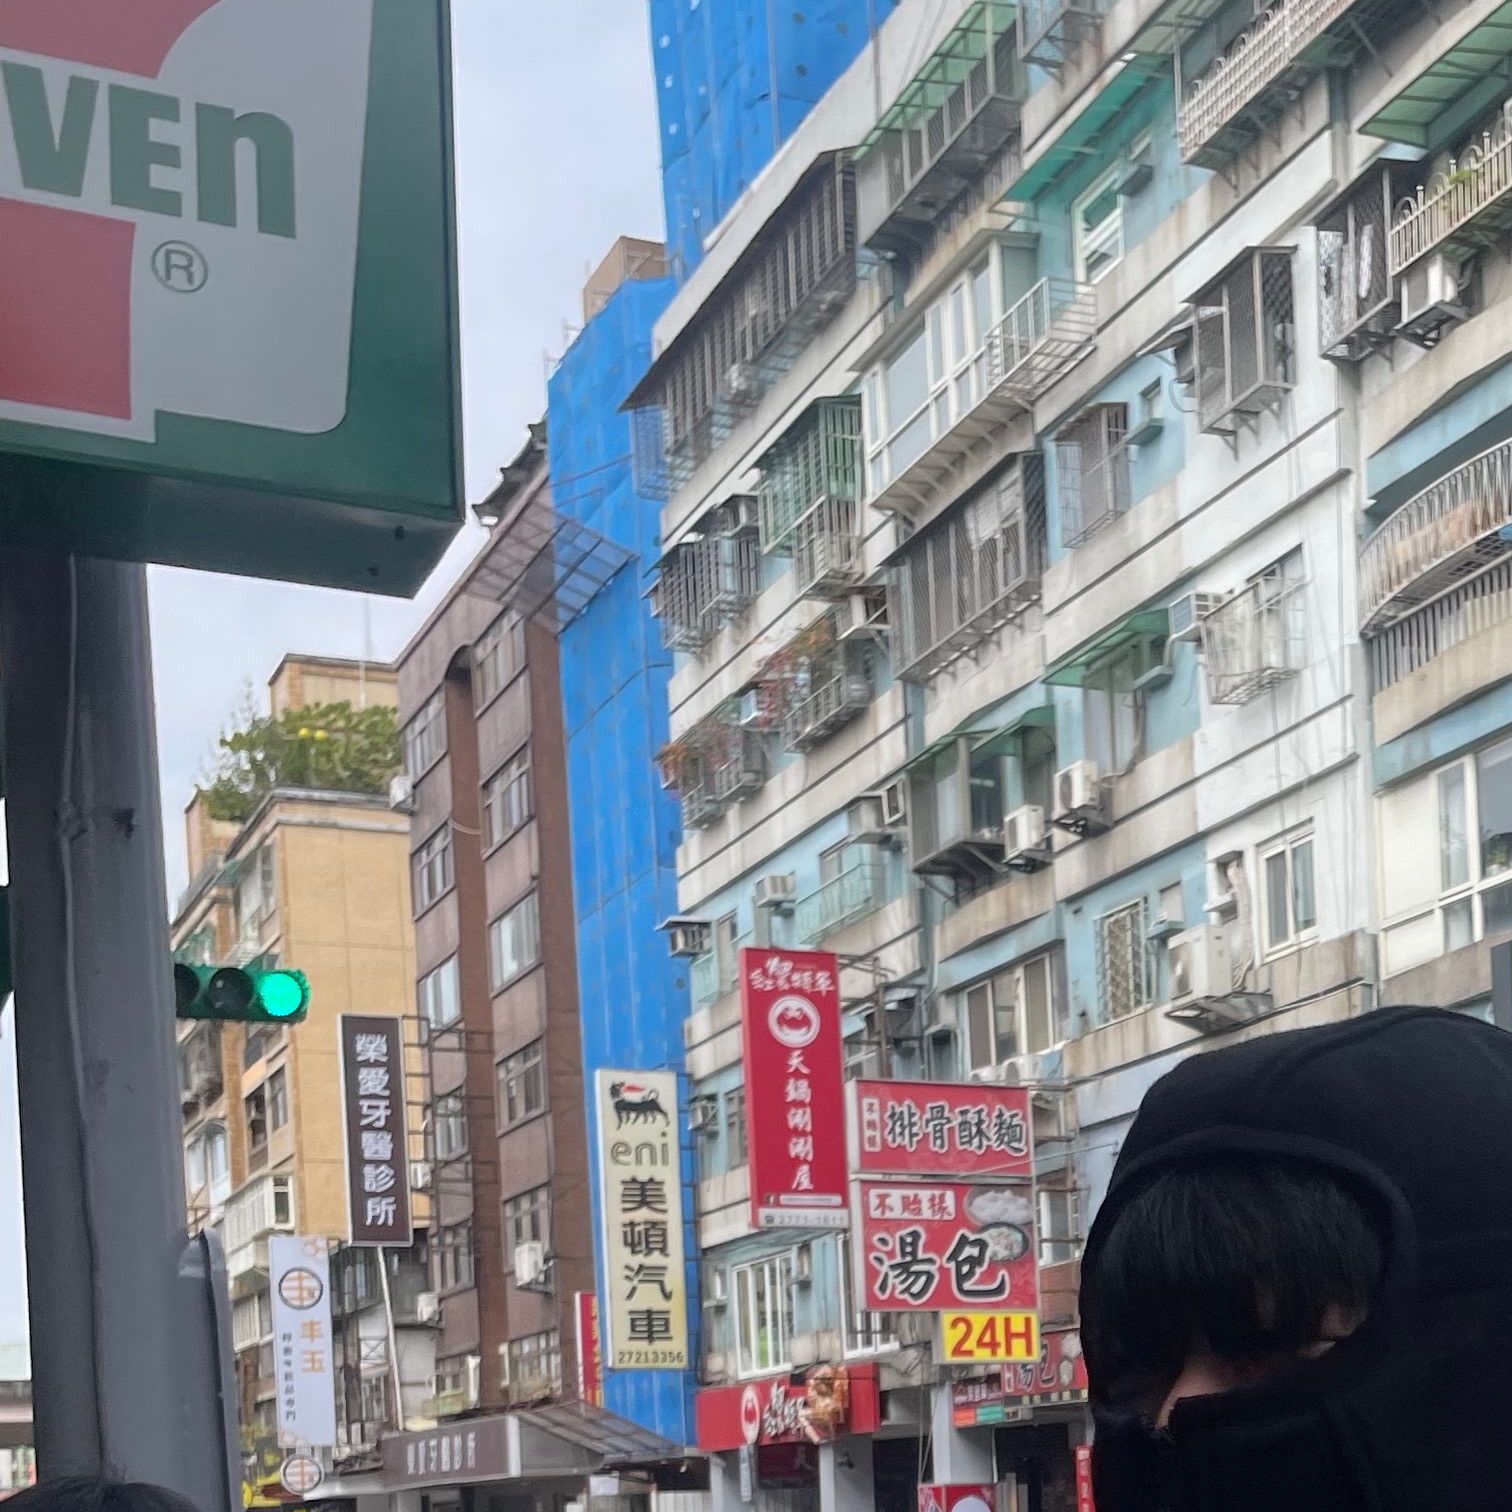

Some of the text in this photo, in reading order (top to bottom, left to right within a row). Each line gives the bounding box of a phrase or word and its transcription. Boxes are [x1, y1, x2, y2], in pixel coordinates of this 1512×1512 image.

[354, 1032, 398, 1228] 榮愛牙醫診所
[611, 1132, 670, 1167] eni
[887, 1103, 1025, 1153] 排骨酥麵
[620, 1176, 672, 1345] 美頓汽車
[873, 1230, 1006, 1300] 湯包
[618, 1351, 684, 1364] 27213356
[950, 1315, 1034, 1359] 24H
